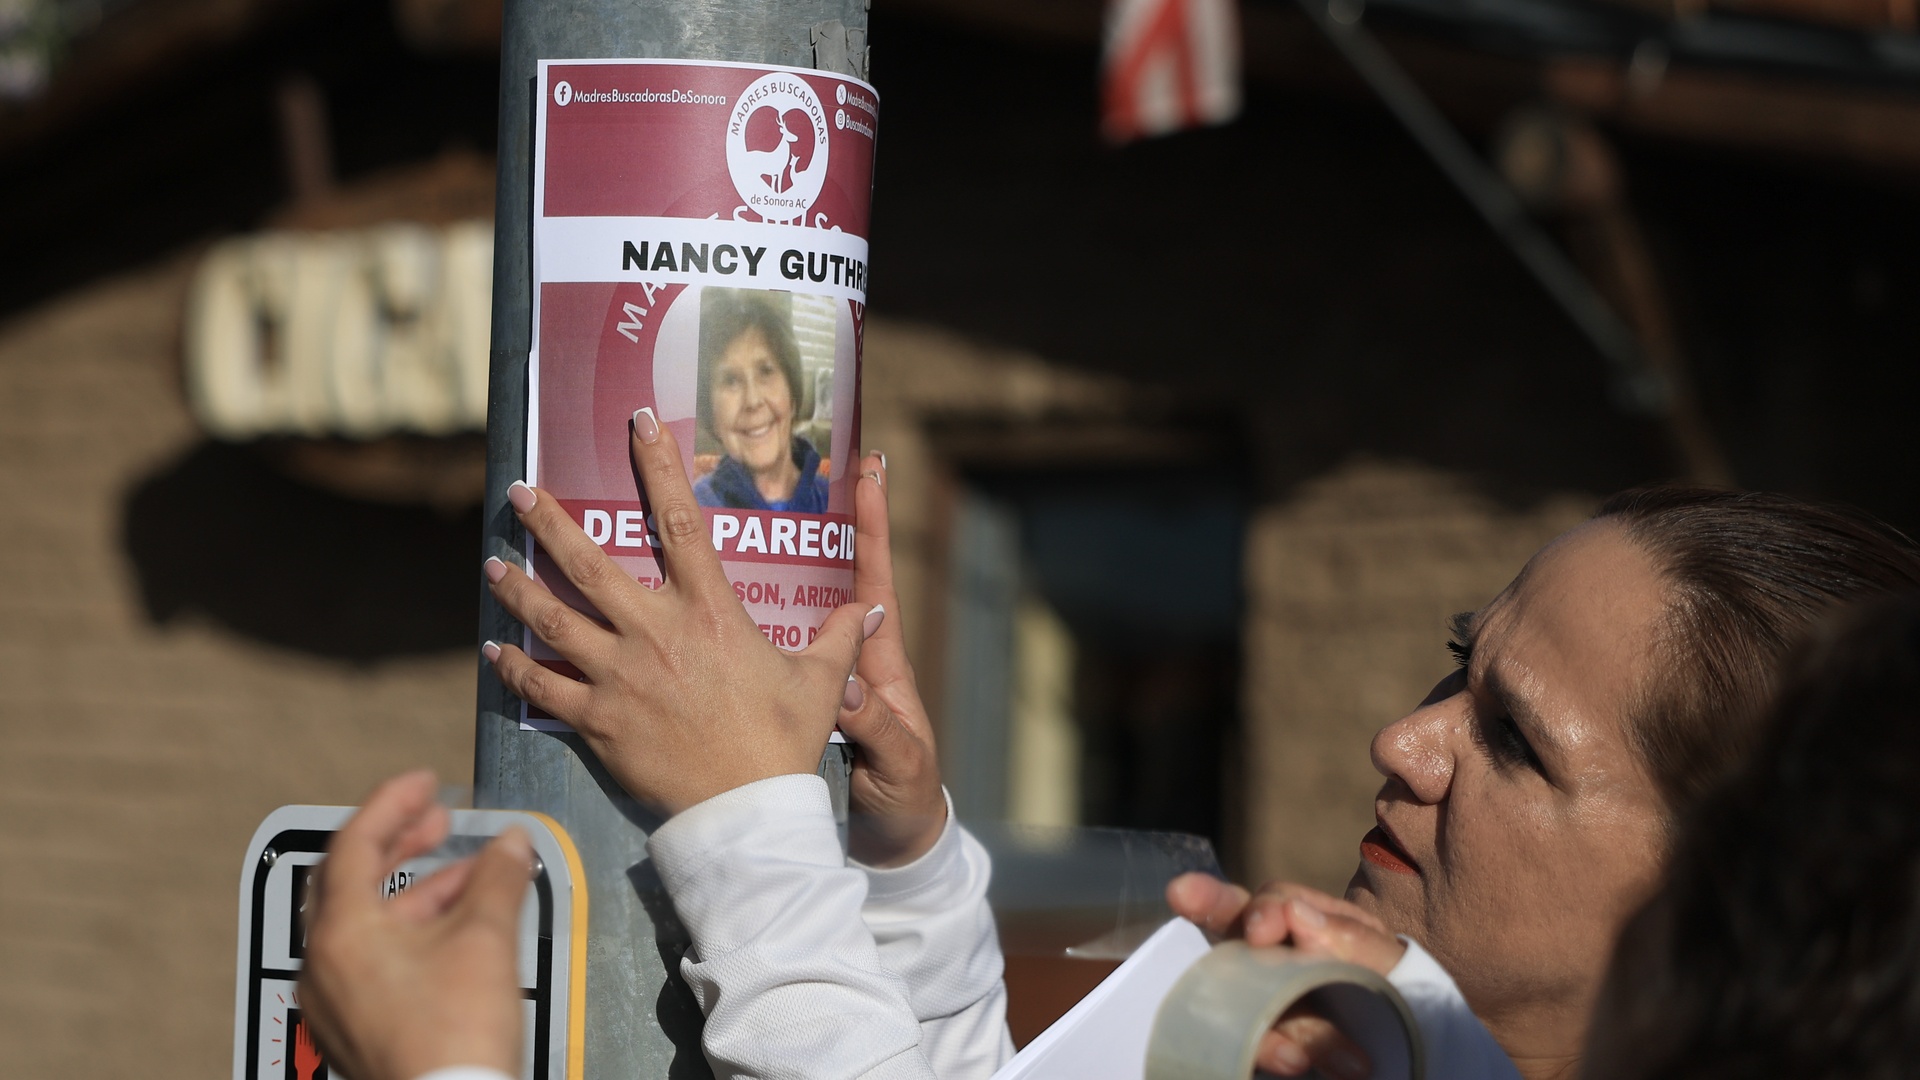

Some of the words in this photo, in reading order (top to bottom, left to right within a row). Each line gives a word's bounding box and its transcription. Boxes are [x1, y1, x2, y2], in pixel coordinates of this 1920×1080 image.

[574, 88, 726, 105] MadresBuscadorasDeSonora
[731, 86, 768, 136] MADRES
[770, 82, 827, 144] BUSCADORAS
[750, 194, 762, 205] de
[763, 195, 794, 208] Sonora
[795, 198, 807, 209] AC
[622, 240, 767, 276] NANCY
